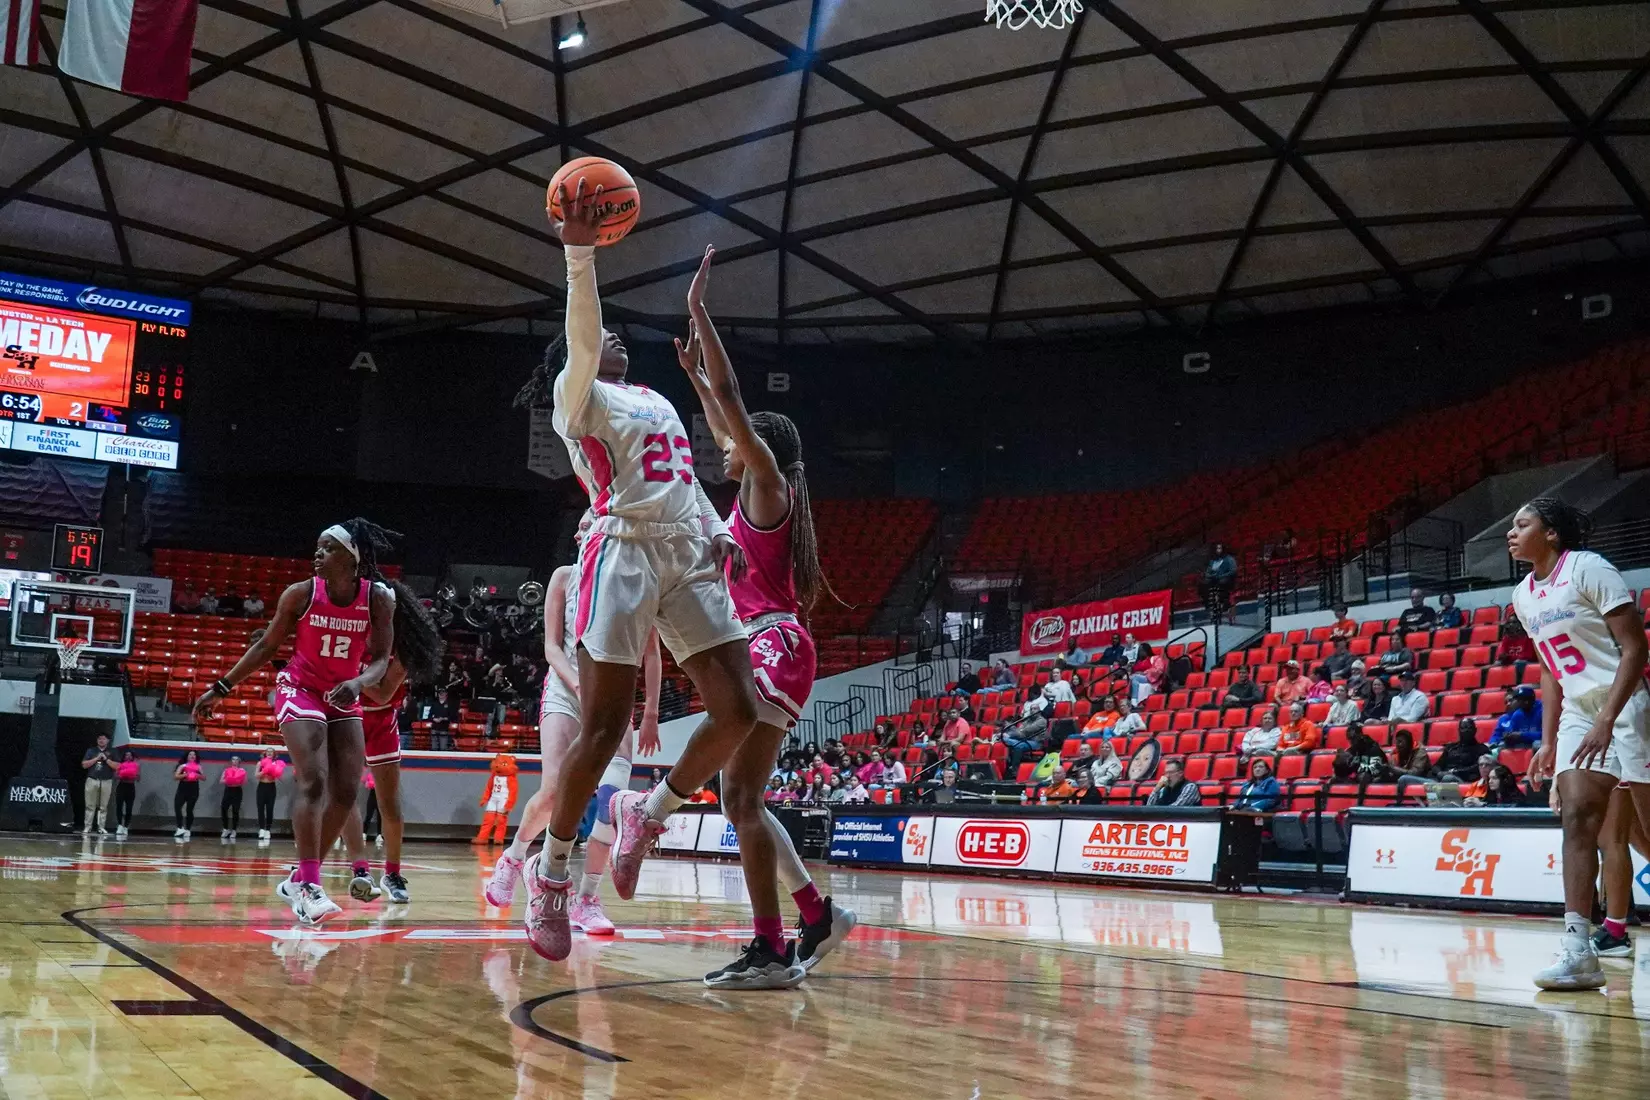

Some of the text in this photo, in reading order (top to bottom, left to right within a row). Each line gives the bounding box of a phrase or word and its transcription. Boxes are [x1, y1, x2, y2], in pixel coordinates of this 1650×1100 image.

[26, 283, 40, 292] THE
[86, 293, 185, 318] BUD LIGHT
[1581, 294, 1612, 320] D
[46, 316, 58, 324] LA
[60, 318, 85, 328] TECH
[142, 322, 186, 338] PLY FL PTS
[349, 351, 378, 373] A
[1183, 352, 1211, 373] C
[136, 371, 150, 382] 23
[767, 373, 790, 392] B
[135, 383, 182, 399] 30 0 0
[2, 394, 40, 411] 6:54
[70, 402, 82, 417] 2
[16, 411, 31, 420] 1ST
[147, 417, 169, 425] BUD
[142, 421, 171, 430] LIGHT
[26, 435, 81, 448] FINANCIAL
[40, 429, 70, 439] FIRST
[38, 443, 68, 453] BANK
[105, 445, 170, 461] USED CARS
[70, 545, 92, 568] 19
[310, 614, 369, 632] SAM HOUSTON
[1070, 605, 1164, 637] CANIAC CREW
[1030, 616, 1065, 644] Cane's
[320, 634, 352, 659] 12
[1538, 633, 1587, 680] 15
[10, 785, 67, 797] MEMORIAL
[10, 793, 67, 804] HERMANN
[835, 821, 882, 831] The Official Internet
[832, 832, 853, 842] provider
[853, 833, 859, 841] of
[872, 833, 895, 842] Athletics
[1088, 823, 1188, 847] ARTECH
[1083, 847, 1111, 856] SIGNS
[1168, 851, 1188, 860] INC.
[1091, 861, 1174, 875] 936.435.9966
